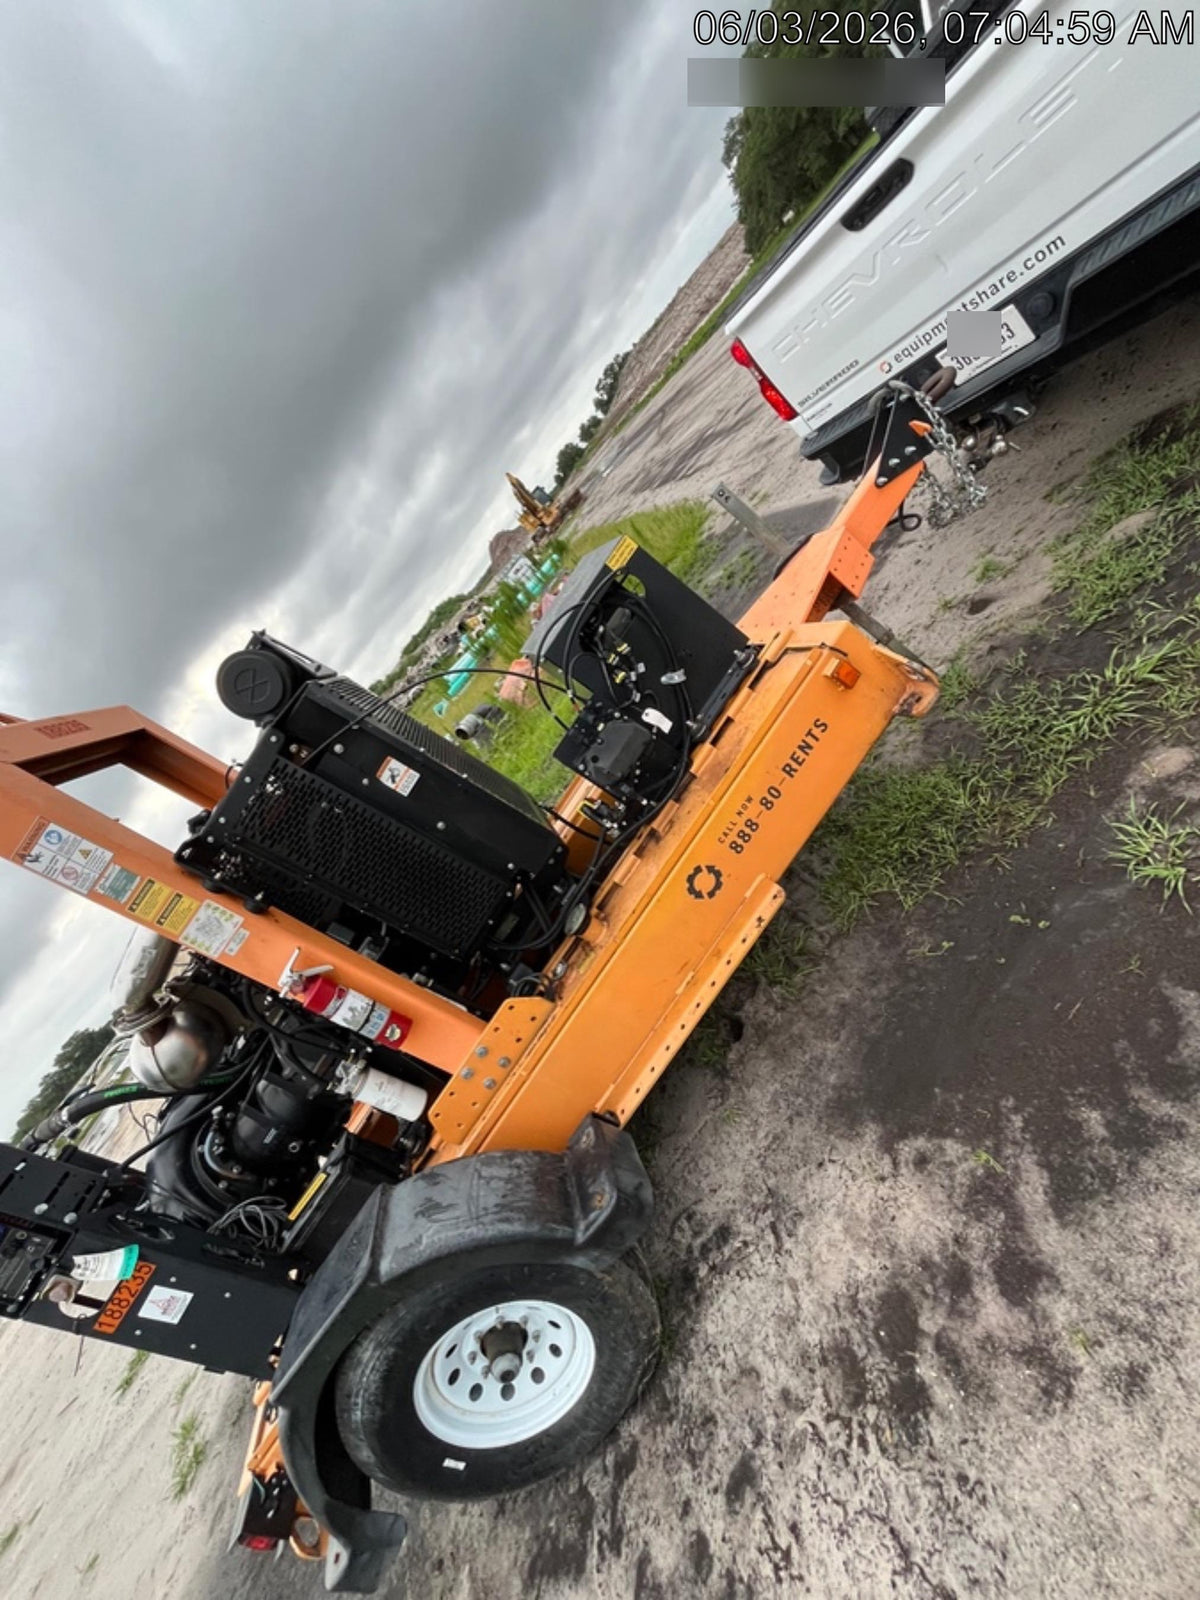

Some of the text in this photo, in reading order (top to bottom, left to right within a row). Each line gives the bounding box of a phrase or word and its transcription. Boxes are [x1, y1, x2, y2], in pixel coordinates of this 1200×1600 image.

[893, 233, 1066, 365] equipmtshare.com
[718, 795, 754, 844] CALL NOW
